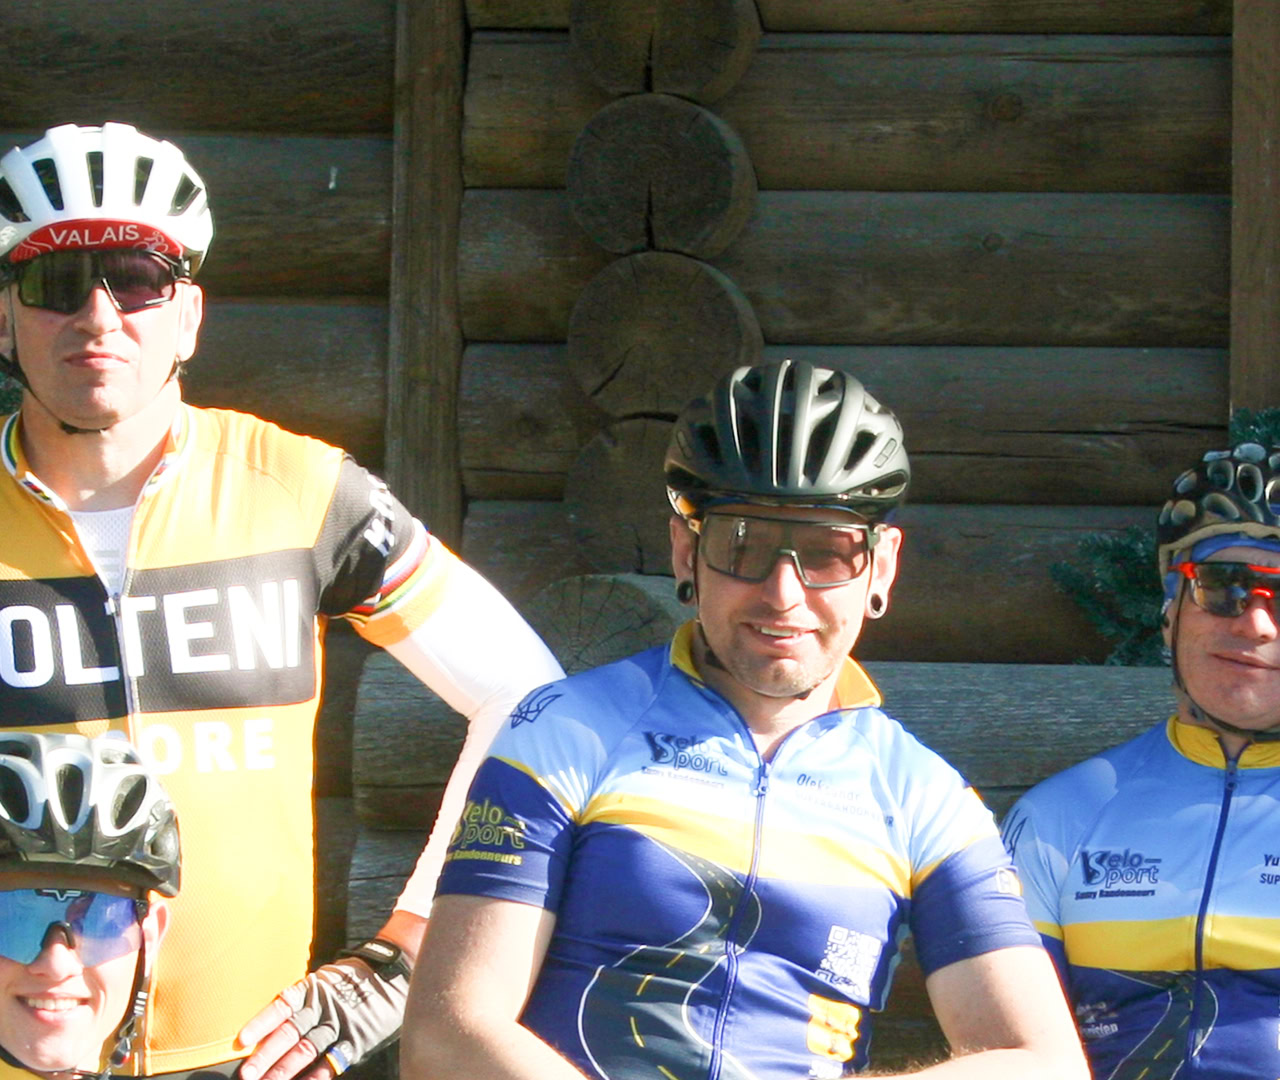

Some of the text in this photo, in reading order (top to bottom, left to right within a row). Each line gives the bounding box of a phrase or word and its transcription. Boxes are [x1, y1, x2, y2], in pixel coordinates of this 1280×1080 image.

[49, 224, 140, 246] VALAIS
[105, 717, 276, 776] ORE
[1083, 851, 1159, 888] Sport
